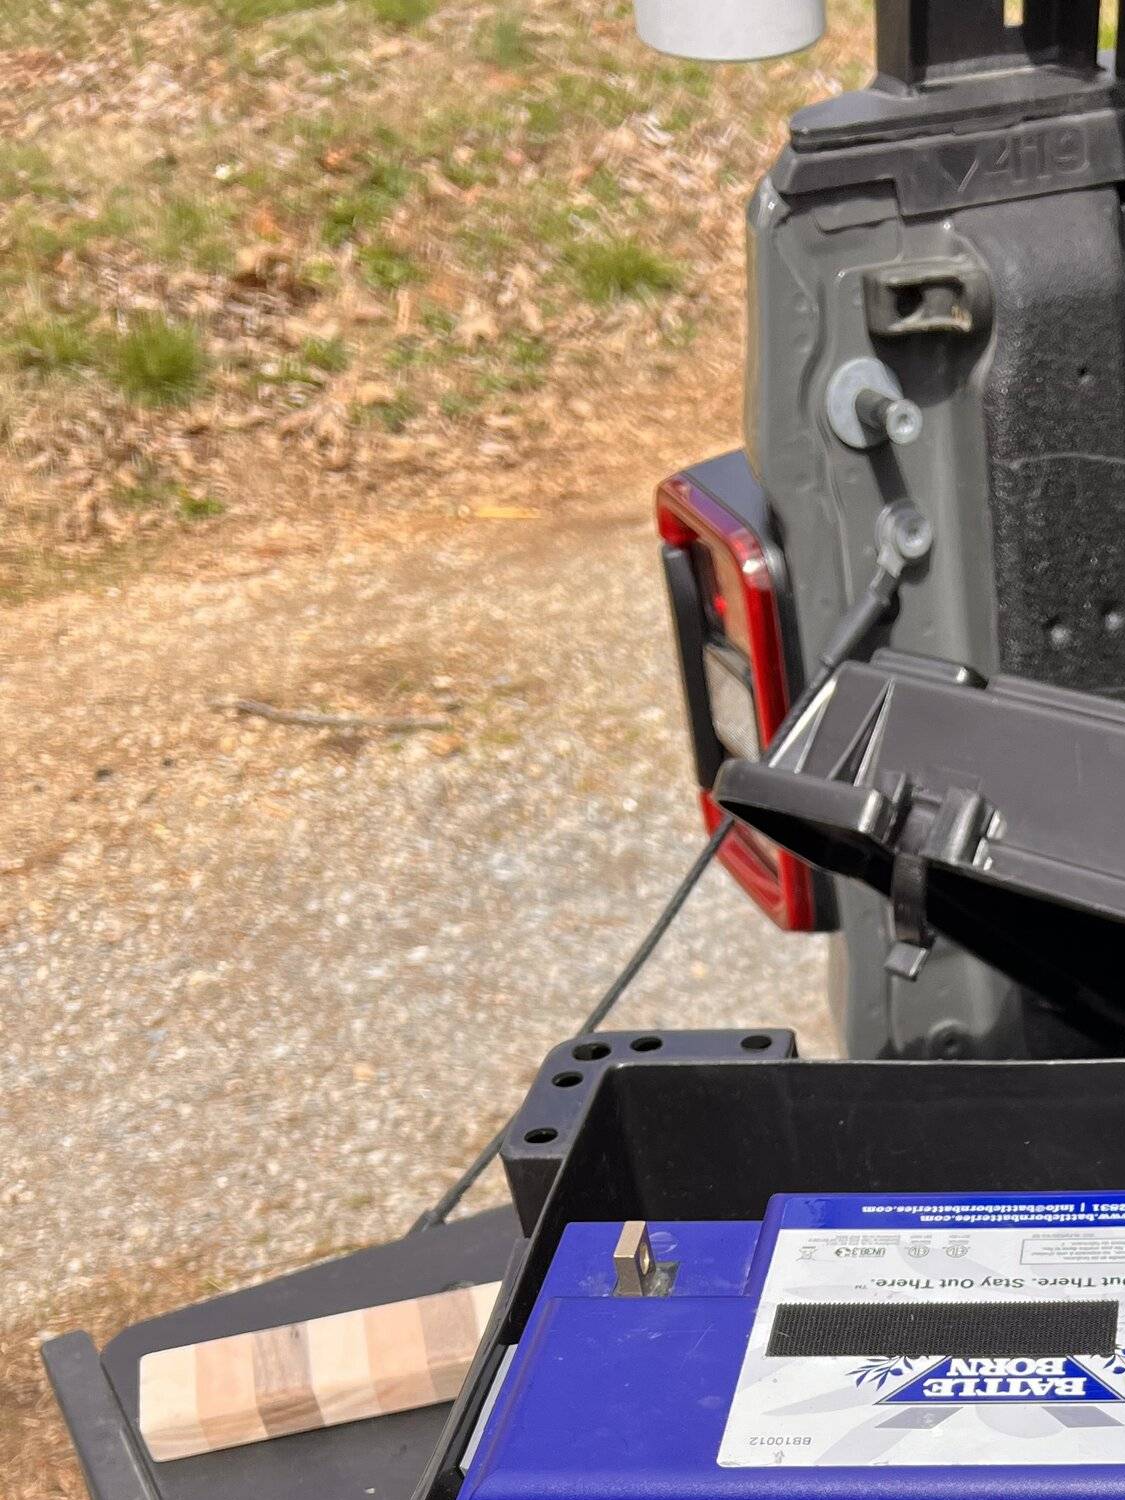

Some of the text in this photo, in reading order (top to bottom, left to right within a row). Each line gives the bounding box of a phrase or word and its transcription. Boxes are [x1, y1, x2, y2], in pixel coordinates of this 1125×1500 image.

[862, 1204, 1074, 1214] info@battlebornbatteries.com
[940, 1278, 974, 1289] Out
[982, 1276, 1025, 1289] Stay
[1032, 1277, 1096, 1288] There.
[946, 1358, 1067, 1376] BORN
[923, 1377, 1087, 1396] BATTLE
[750, 1437, 811, 1446] BB10012
